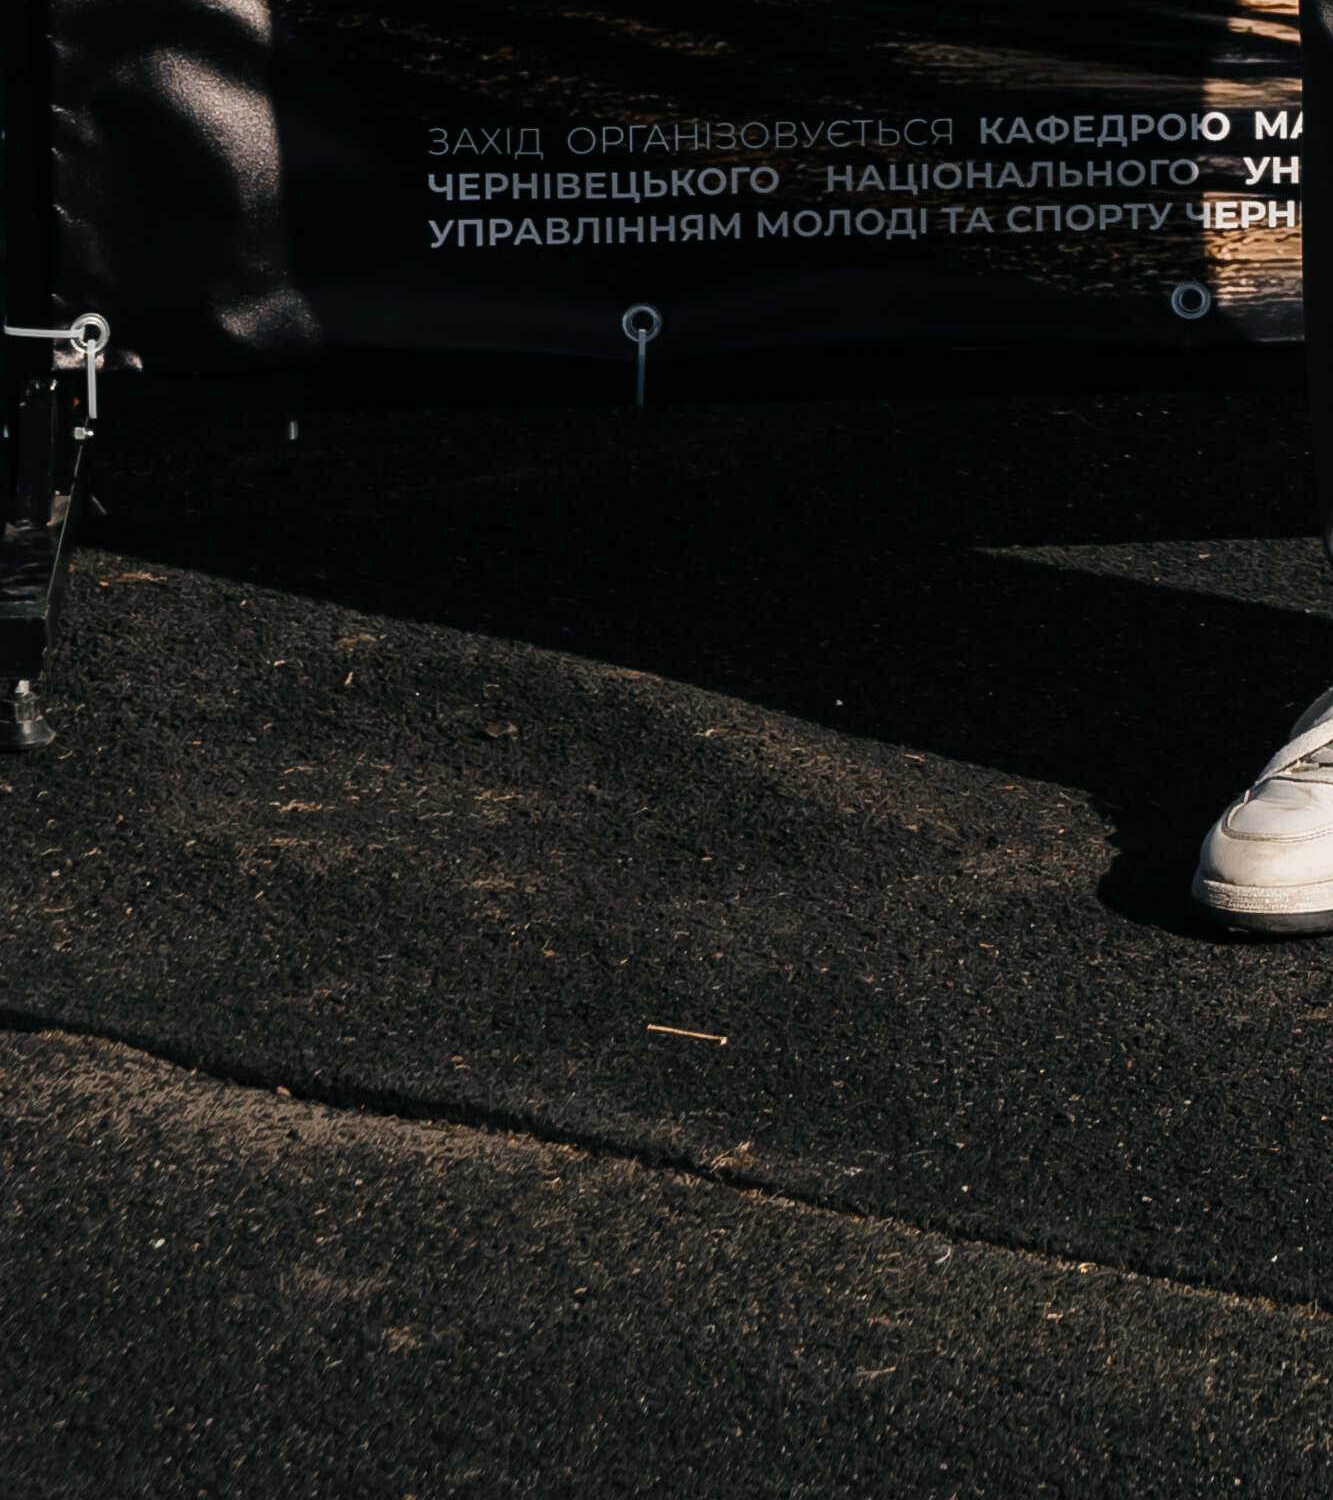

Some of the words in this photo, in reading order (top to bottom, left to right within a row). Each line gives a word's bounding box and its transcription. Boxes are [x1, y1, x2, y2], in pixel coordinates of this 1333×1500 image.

[427, 126, 545, 164] ЗАХІД
[567, 115, 955, 156] ОРГАНІЗОВУЄТЬСЯ
[979, 110, 1231, 149] КАФЕДРОЮ
[427, 164, 781, 206] ЧЕРНІВЕЦЬКОГО
[826, 158, 1200, 196] НАЦІОНАЛЬНОГО
[427, 212, 742, 251] УПРАВЛІННЯМ
[756, 208, 929, 242] МОЛОДІ
[939, 205, 996, 233] ТА
[1006, 202, 1174, 233] СПОРТУ
